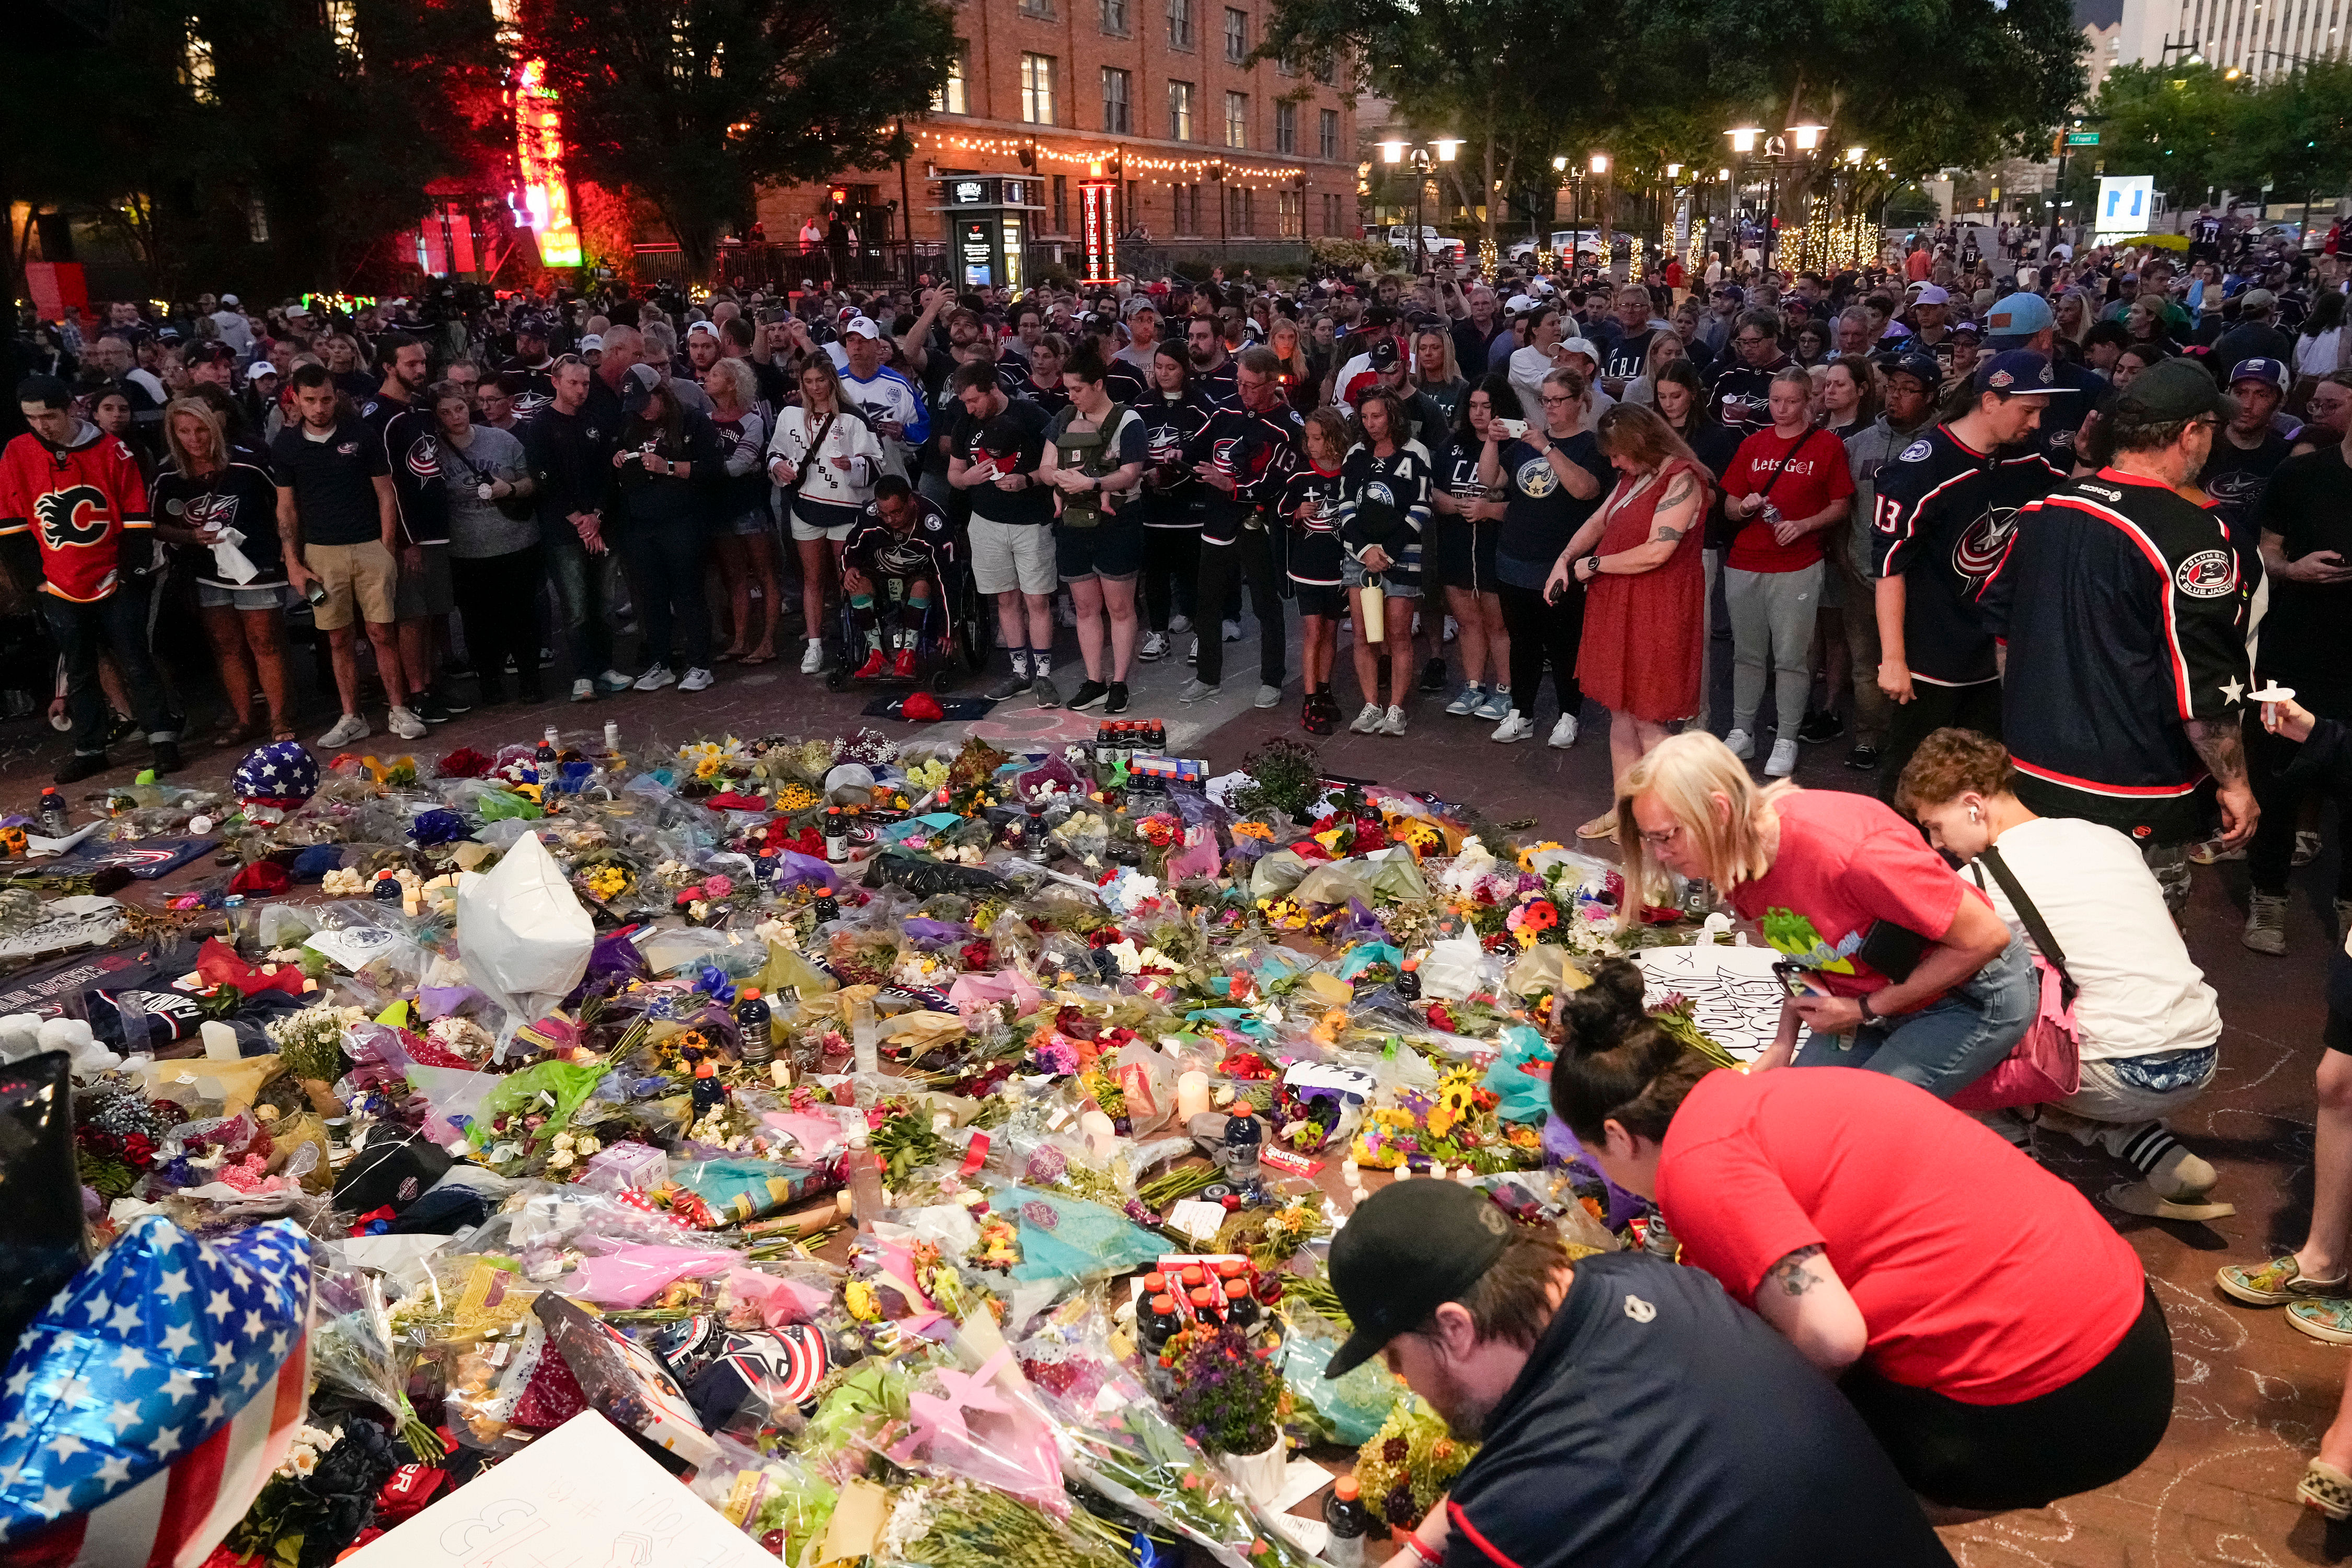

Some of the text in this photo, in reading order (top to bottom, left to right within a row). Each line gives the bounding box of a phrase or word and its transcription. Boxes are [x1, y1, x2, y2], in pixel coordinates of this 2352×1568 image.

[957, 182, 982, 192] ARENA
[1086, 188, 1097, 245] WHISTLE
[1967, 252, 1975, 261] 13
[1089, 255, 1099, 279] KEG
[1609, 357, 1640, 376] CBJ
[1275, 448, 1296, 472] 13
[1393, 457, 1412, 480] A
[1875, 494, 1901, 534] 13
[942, 541, 954, 562] 7
[2182, 581, 2233, 595] BLUE JACKE
[1041, 837, 1050, 847] G
[758, 879, 768, 891] G
[1690, 895, 1700, 906] G
[740, 1027, 752, 1041] G
[1226, 1147, 1239, 1163] G
